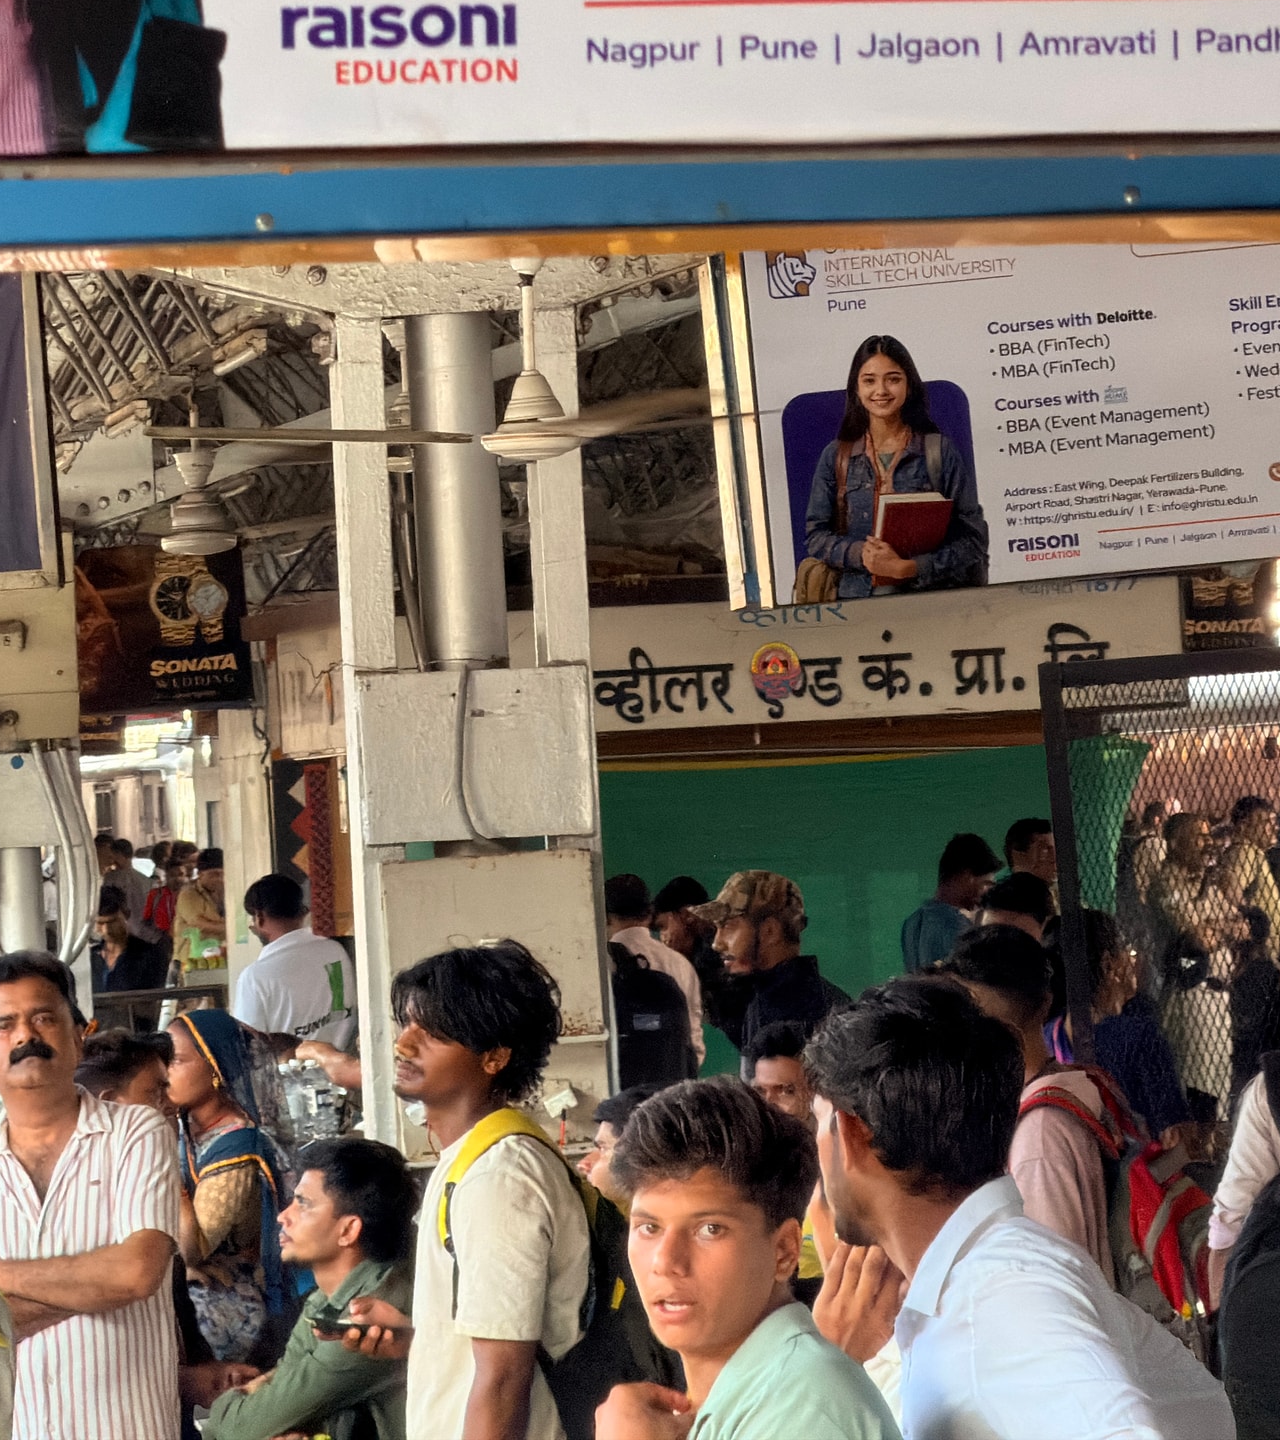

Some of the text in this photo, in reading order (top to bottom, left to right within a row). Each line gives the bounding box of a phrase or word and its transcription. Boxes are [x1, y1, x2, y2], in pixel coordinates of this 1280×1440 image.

[281, 4, 517, 49] raisoni
[586, 37, 700, 69] Nagpur
[740, 34, 818, 60] Pune
[857, 32, 980, 65] Jalgaon
[1019, 28, 1156, 57] Amravati
[335, 58, 518, 85] EDUCATION
[824, 248, 956, 272] INTERNATIONAL
[825, 258, 1016, 288] SKILL TECH UNIVERSITY
[827, 298, 867, 313] Pune
[1228, 295, 1263, 312] Skill
[987, 308, 1157, 335] Courses with Deloitte.
[998, 333, 1111, 357] BBA (FinTech)
[1000, 355, 1116, 379] MBA (FinTech)
[994, 395, 1062, 412] Courses
[1064, 389, 1100, 405] with
[1006, 401, 1210, 434] BBA (Event Management)
[1008, 423, 1216, 457] MBA (Event Management)
[1053, 482, 1078, 493] East
[1078, 480, 1108, 491] Wing,
[1108, 474, 1150, 488] Deepak
[1150, 471, 1200, 484] Fertilizers
[1200, 467, 1245, 479] Building,
[1004, 500, 1042, 513] Airport
[1042, 497, 1073, 509] Road,
[1073, 493, 1111, 506] Shastri
[1111, 492, 1145, 503] Nagar,
[1008, 533, 1080, 553] raisoni
[1098, 540, 1134, 551] Nagpur
[1144, 536, 1169, 545] Pune
[1025, 549, 1081, 562] EDUCATION
[1182, 616, 1265, 636] SONATA
[149, 653, 238, 678] SONATA
[593, 647, 734, 723] व्हीलर
